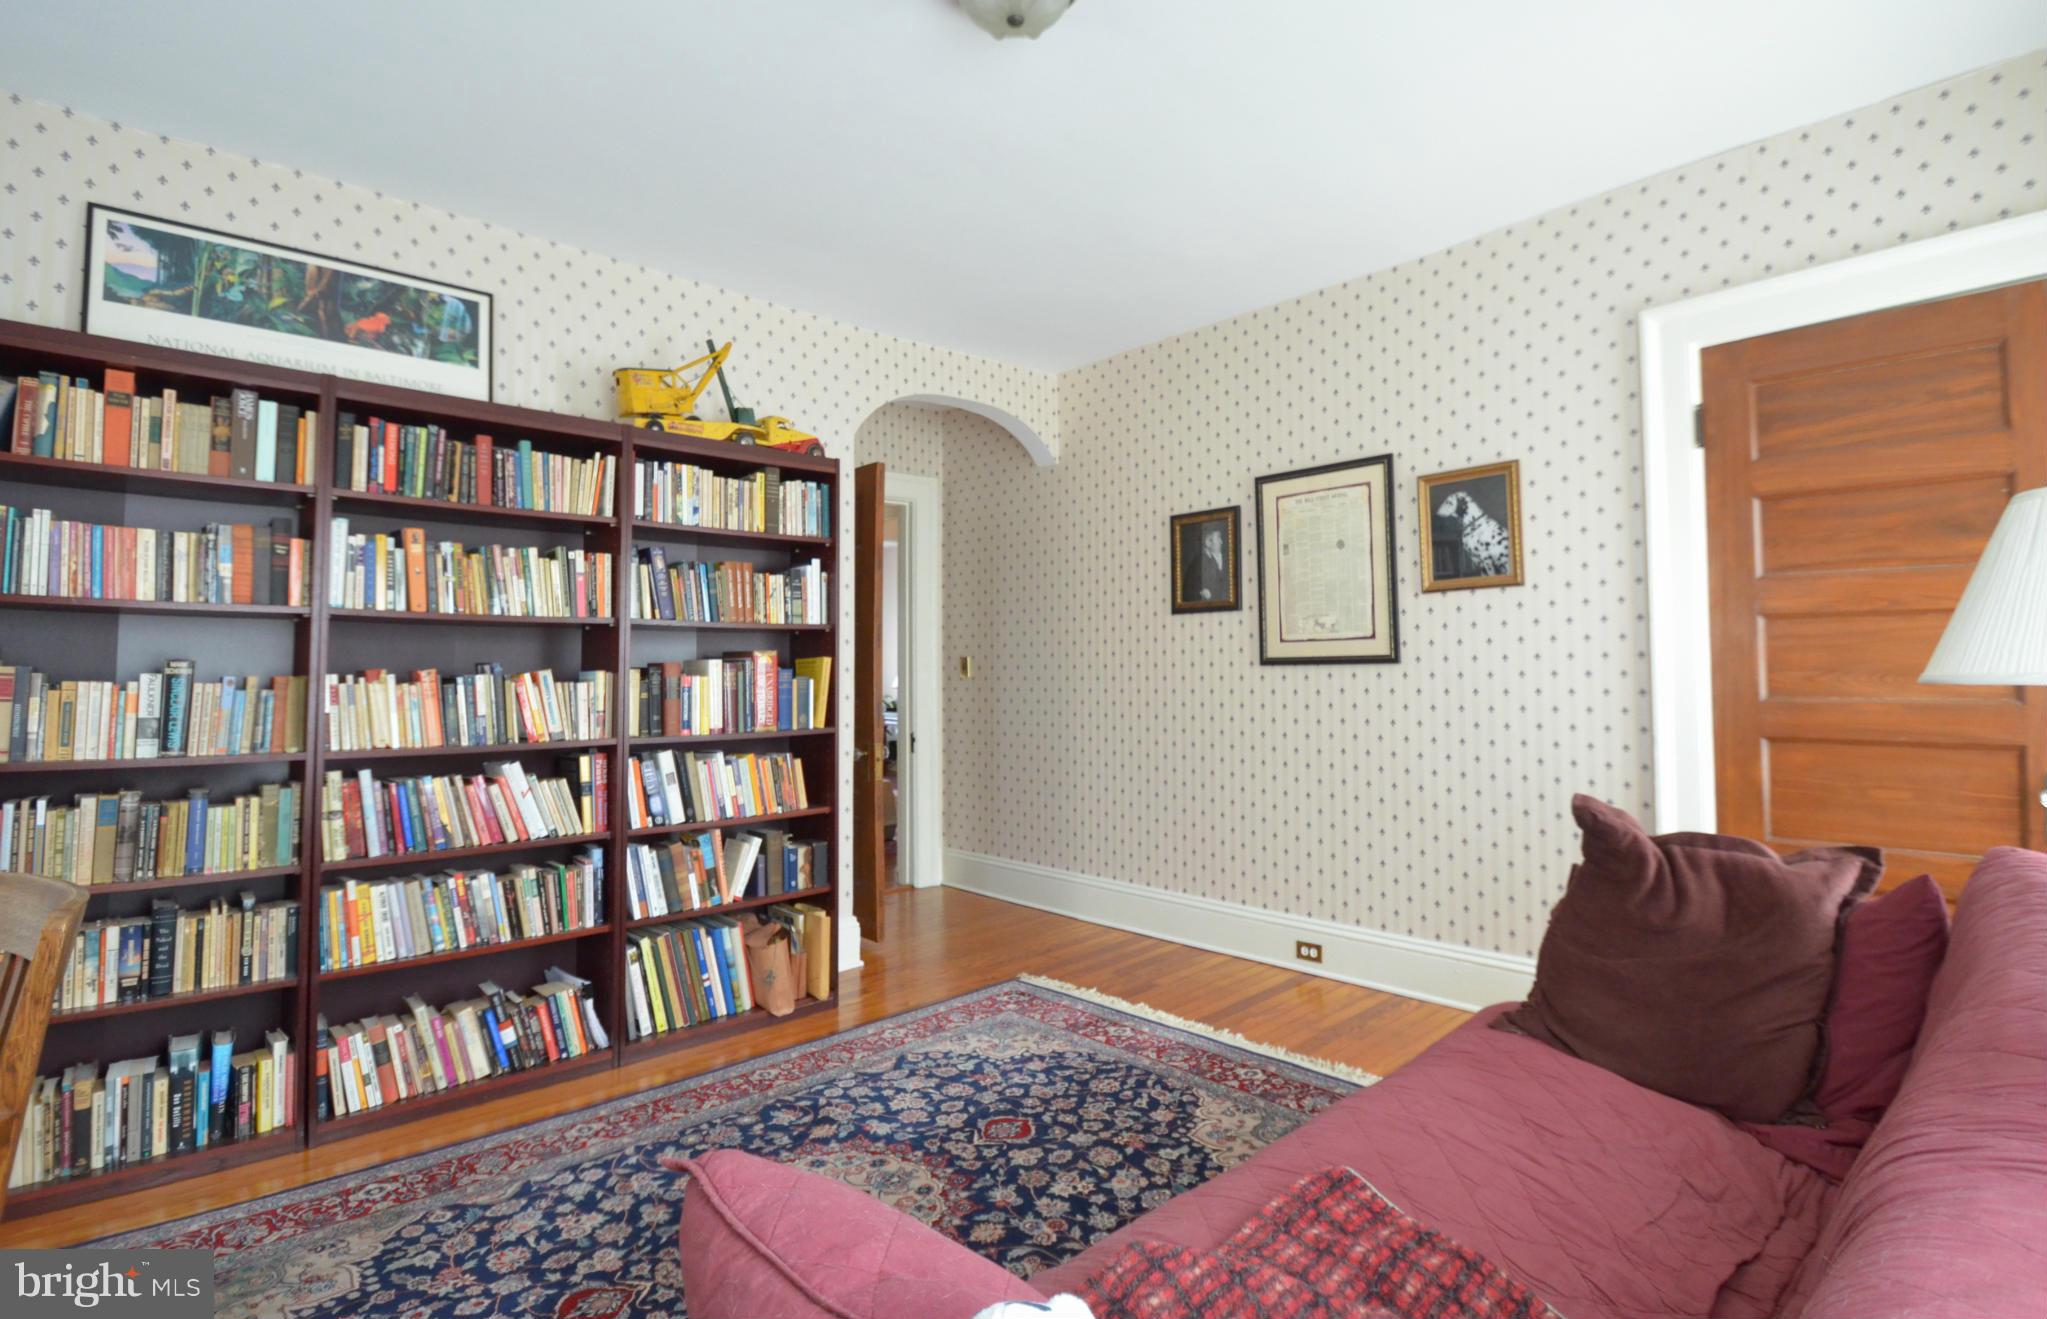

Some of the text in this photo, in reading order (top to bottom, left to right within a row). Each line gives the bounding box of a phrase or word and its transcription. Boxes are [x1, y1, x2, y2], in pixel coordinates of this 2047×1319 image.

[147, 334, 443, 391] NATIONAL AQUARIUM IN BALTIMORE
[147, 674, 158, 717] FAULKNER
[167, 677, 187, 749] SINCLAIR LEWIS
